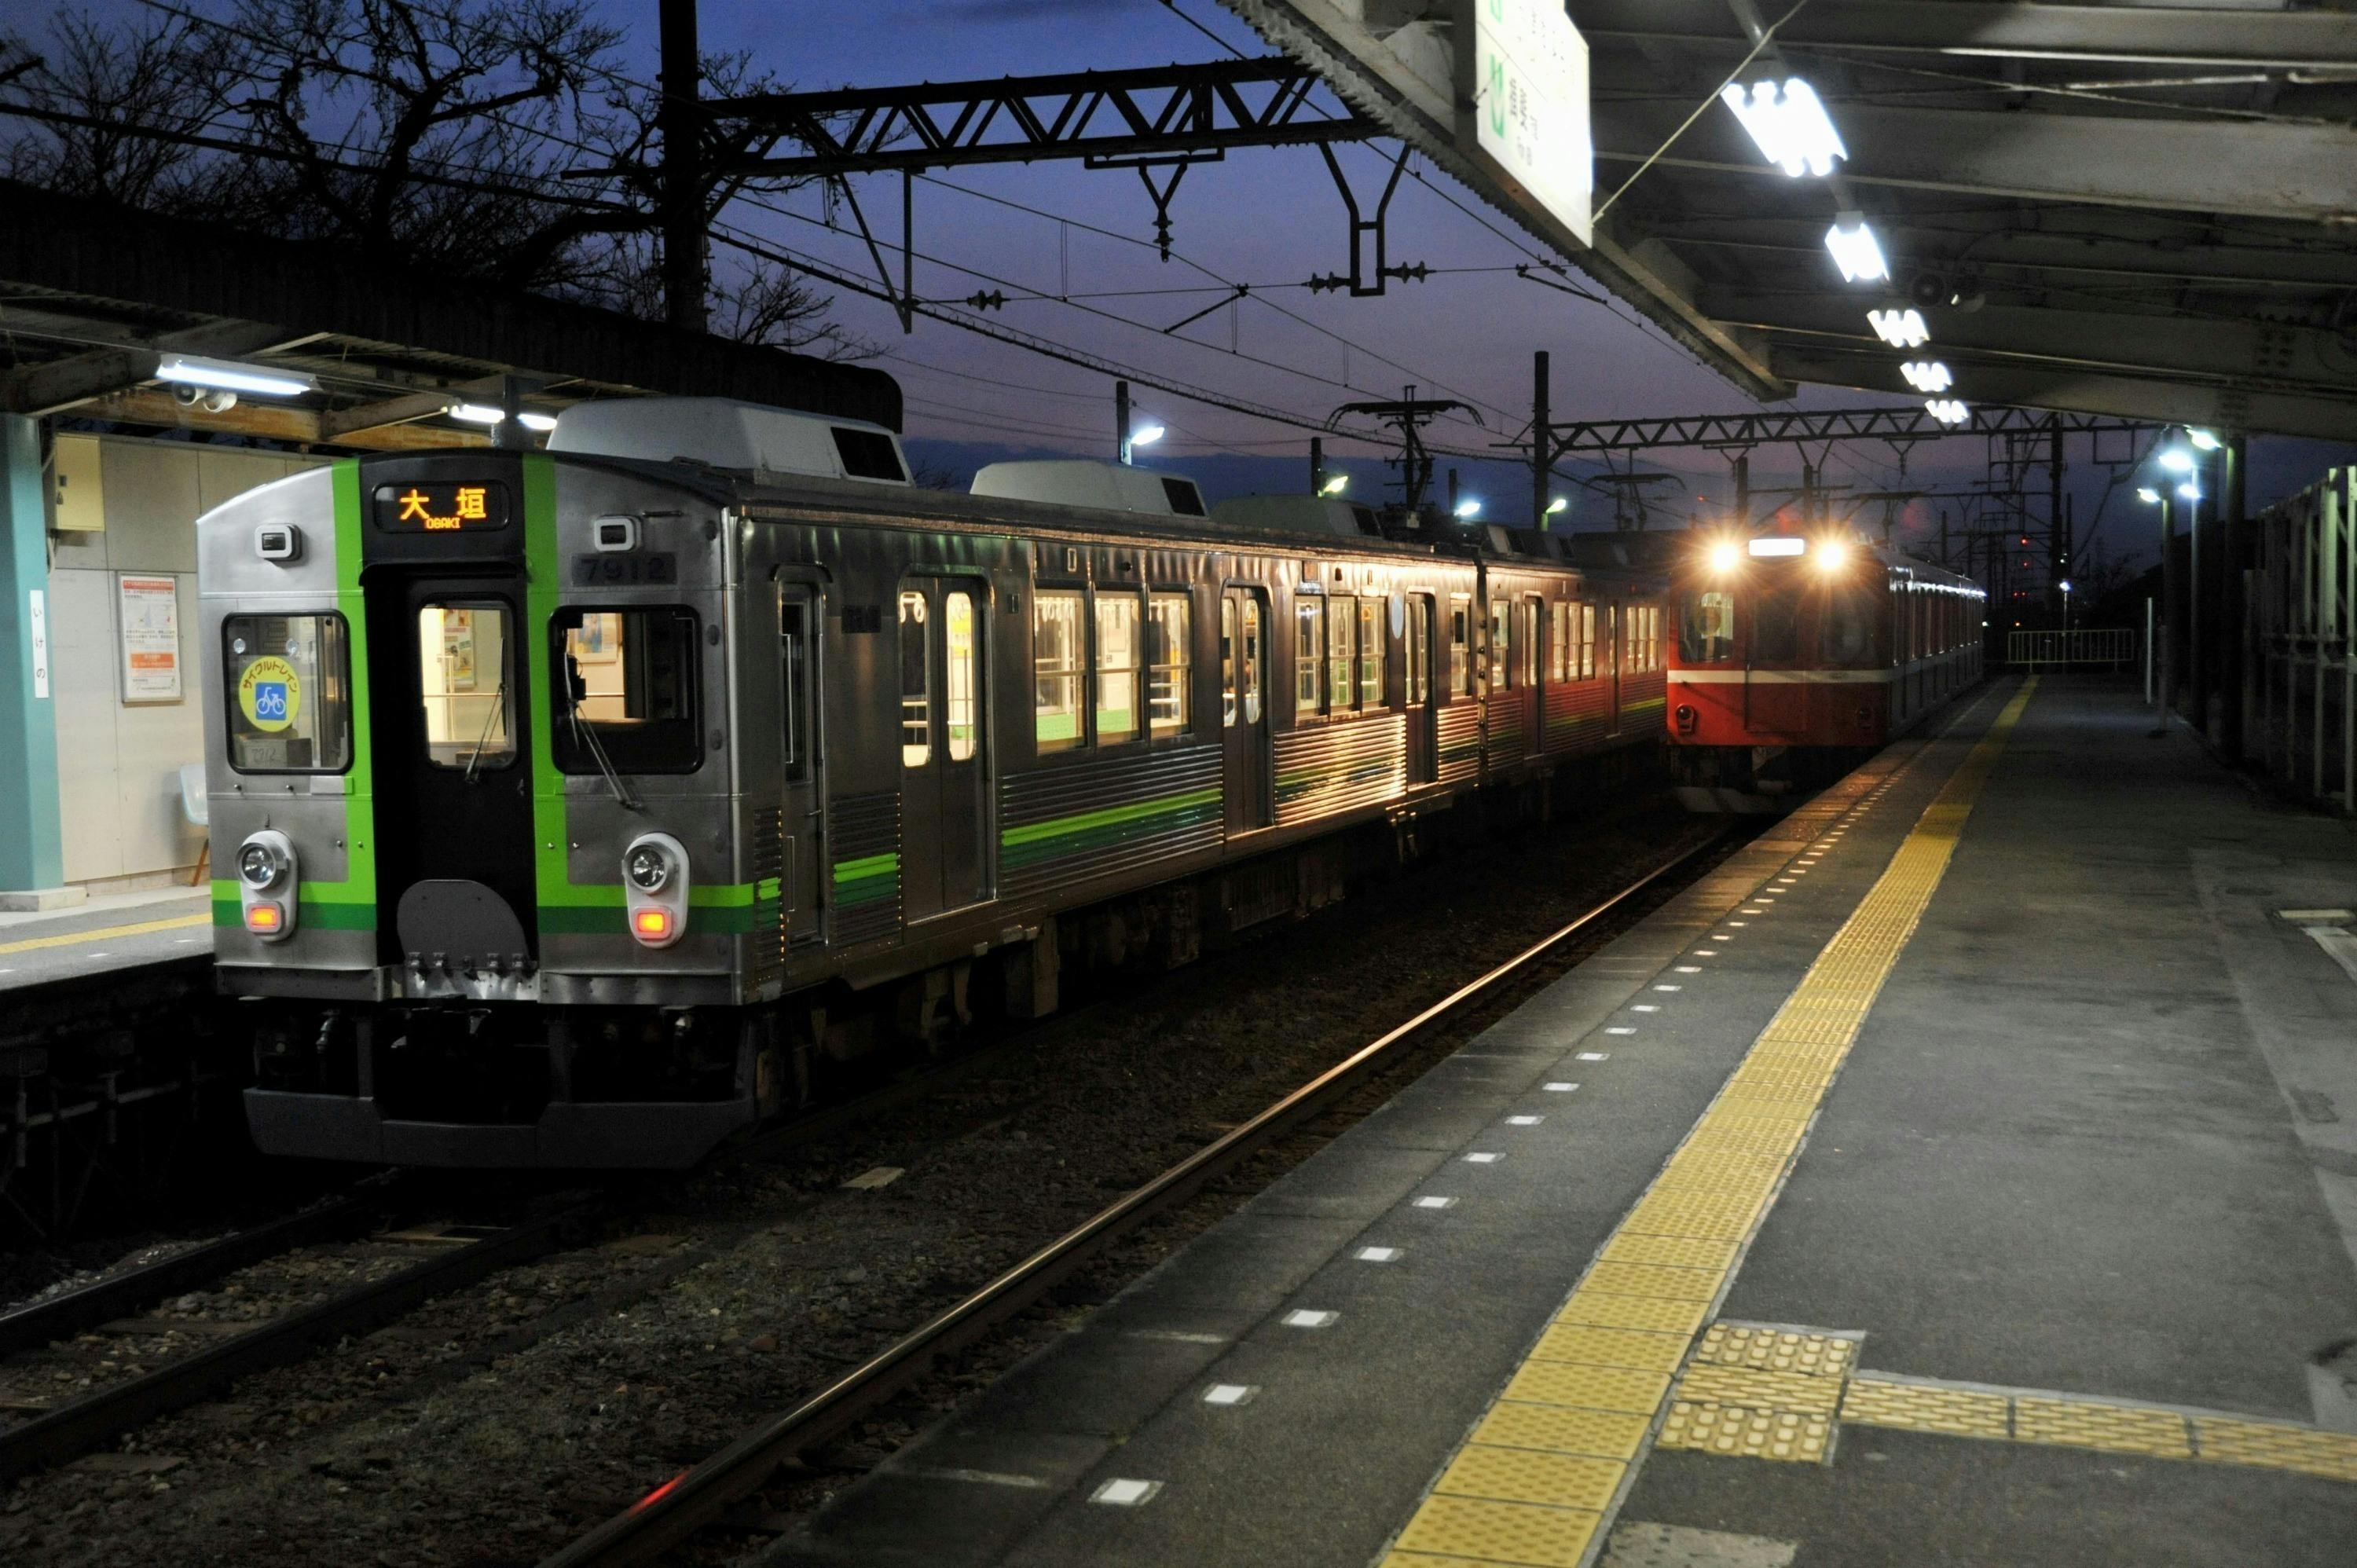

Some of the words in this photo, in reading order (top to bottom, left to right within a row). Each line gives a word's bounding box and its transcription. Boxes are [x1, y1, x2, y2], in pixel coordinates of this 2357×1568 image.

[400, 488, 486, 520] 大垣
[426, 517, 460, 529] OGAKI
[581, 556, 666, 580] 7912
[33, 607, 46, 679] いけの
[243, 661, 297, 693] サイクルトレイン
